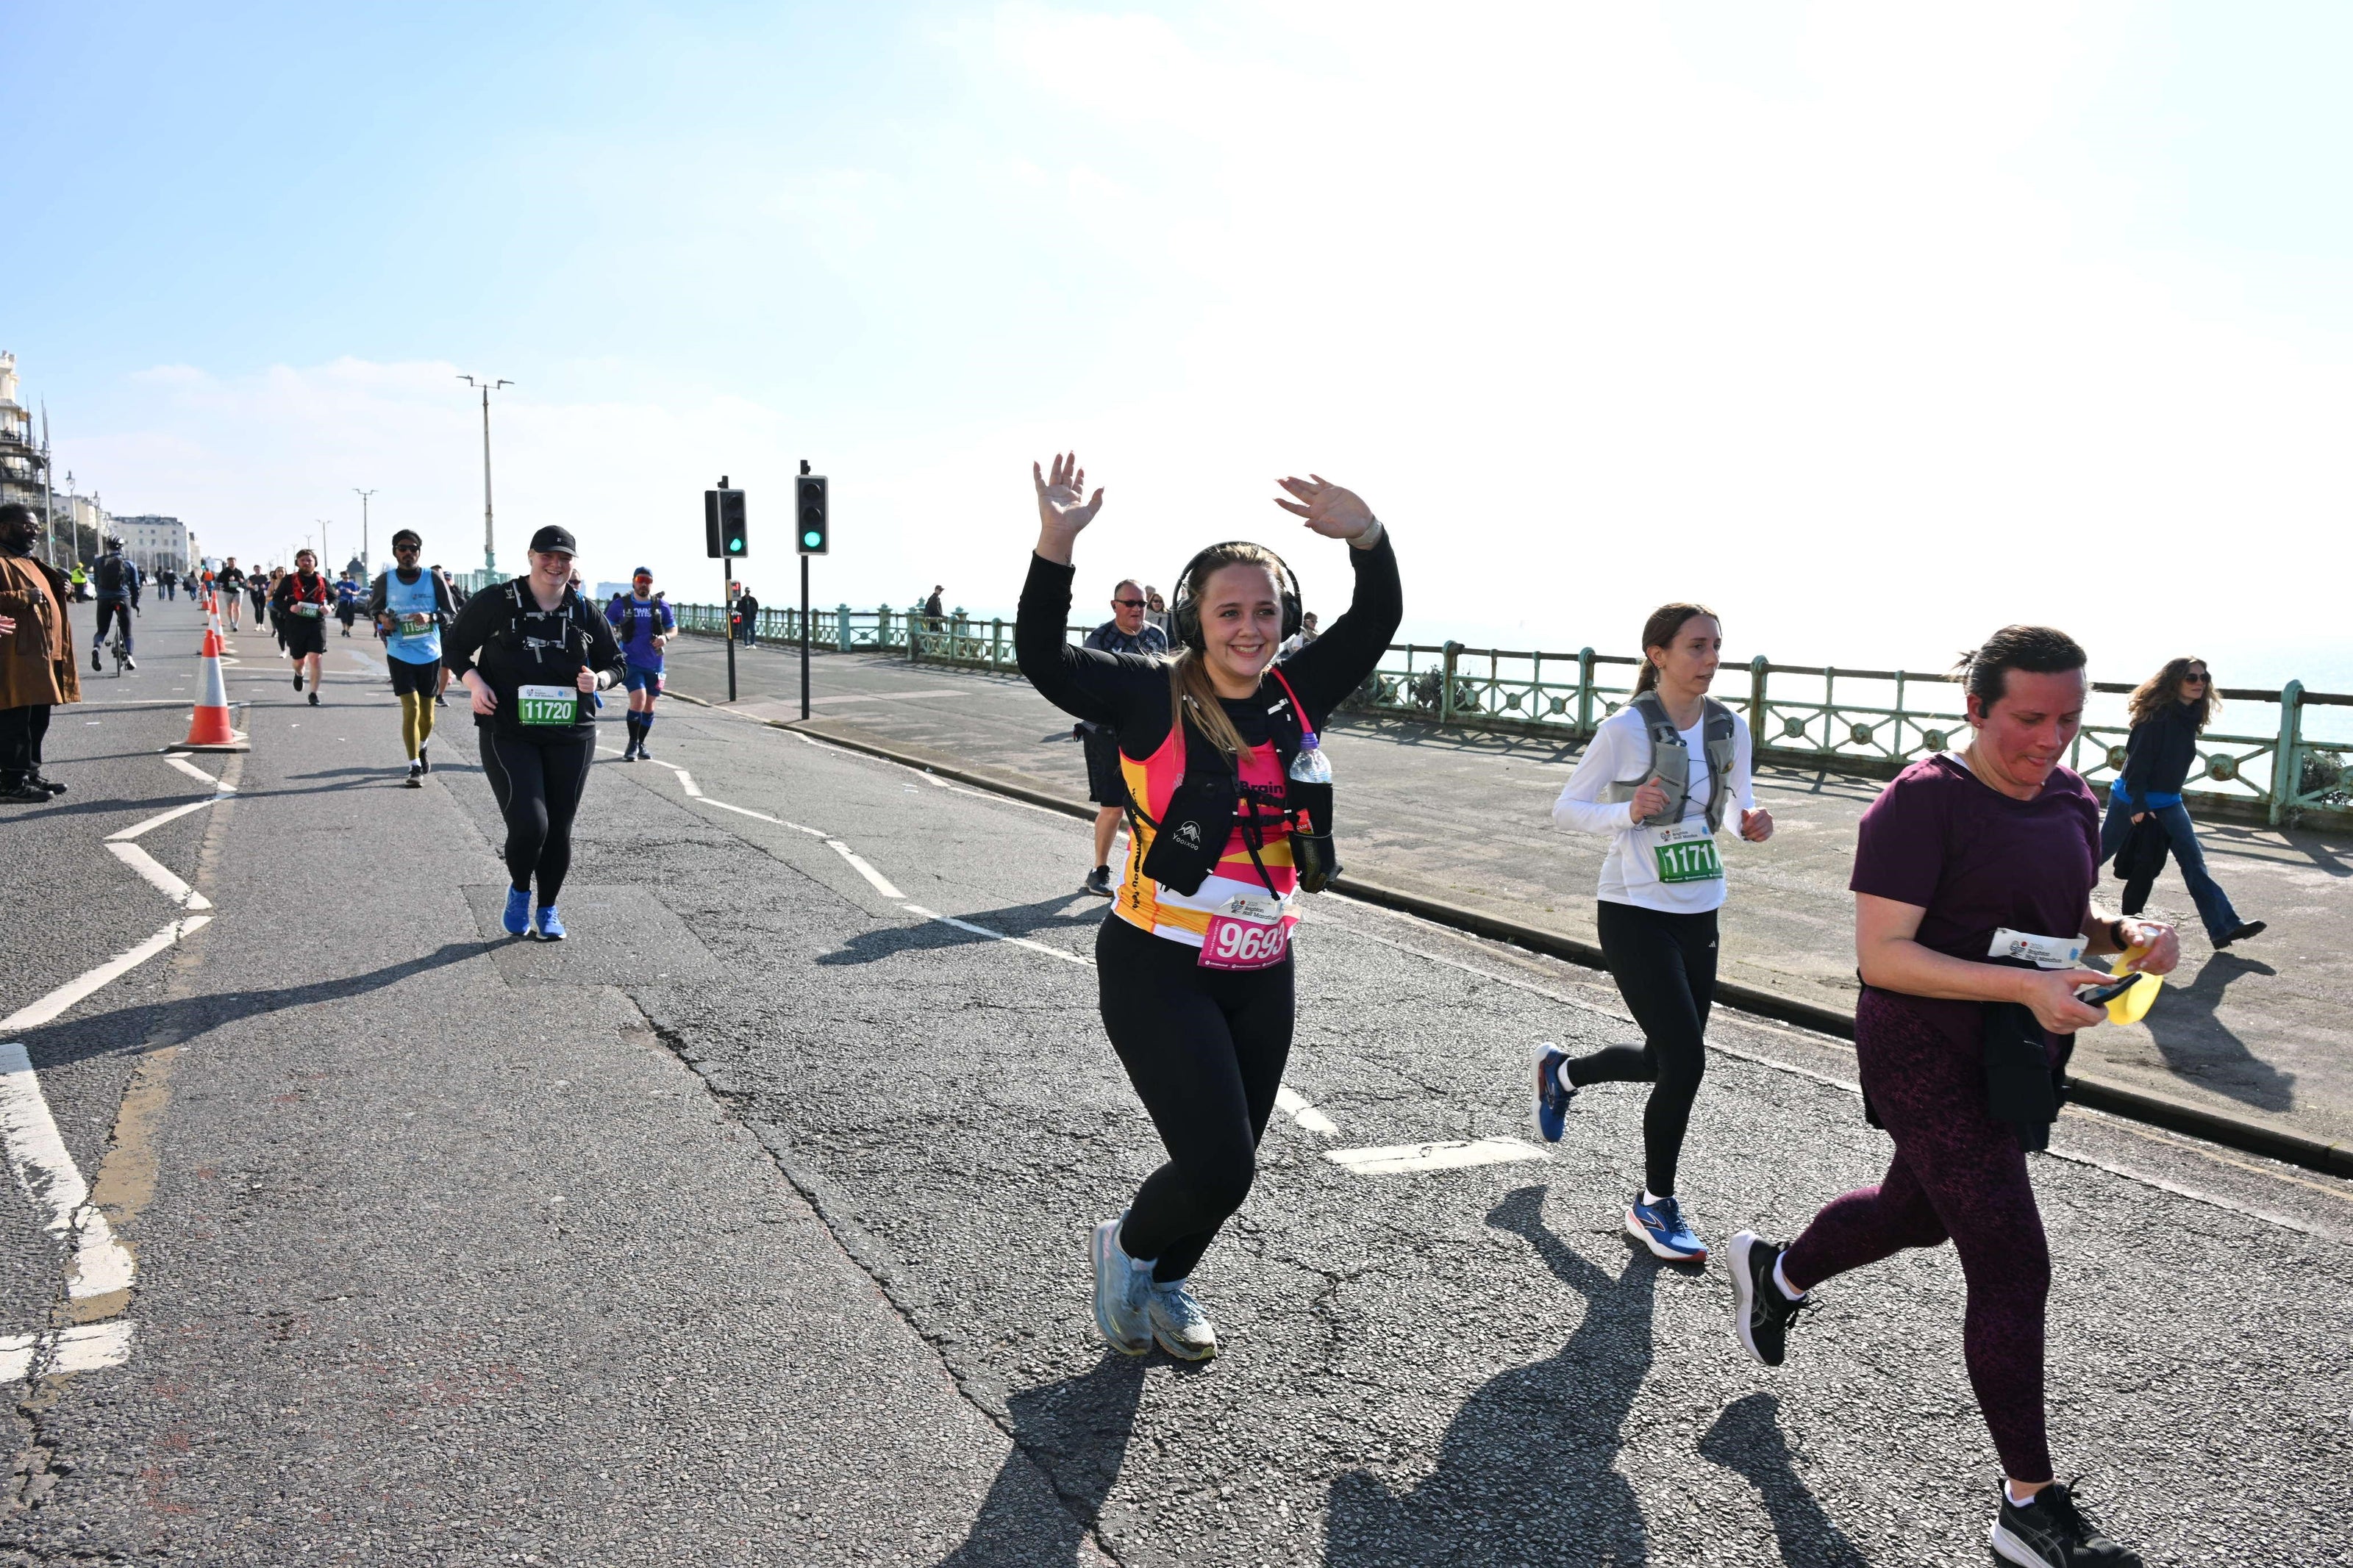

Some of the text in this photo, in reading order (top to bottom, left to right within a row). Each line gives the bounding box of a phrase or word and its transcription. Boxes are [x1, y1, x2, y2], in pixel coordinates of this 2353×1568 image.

[525, 701, 571, 719] 11720
[1240, 781, 1282, 794] Brain
[1217, 921, 1285, 960] 9693
